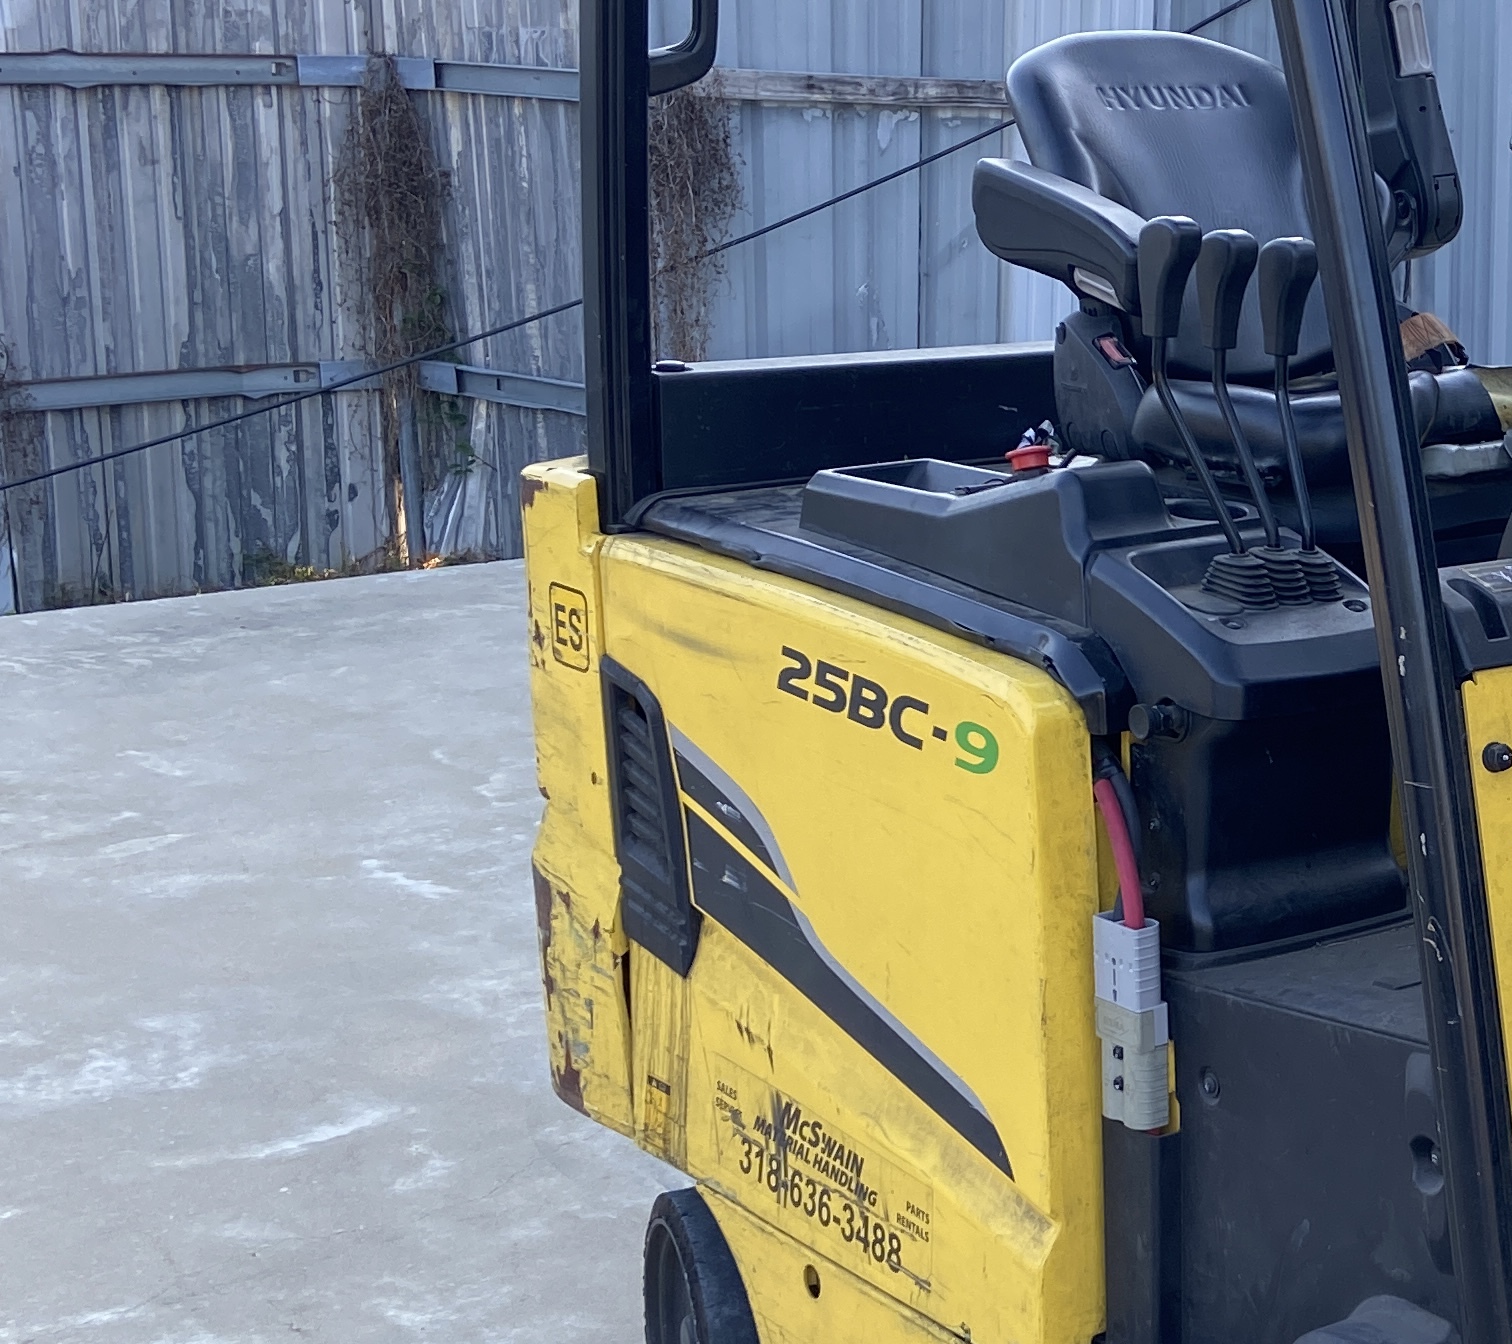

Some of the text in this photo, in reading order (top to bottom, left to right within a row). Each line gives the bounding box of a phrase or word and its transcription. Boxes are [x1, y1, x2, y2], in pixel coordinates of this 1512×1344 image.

[1096, 82, 1251, 111] HYUNDAI
[554, 602, 584, 653] ES
[776, 644, 1000, 775] 25BC-9
[716, 1080, 738, 1101] SALES
[753, 1115, 878, 1207] MARIAL HANDLING
[780, 1100, 865, 1178] McSWAIN
[739, 1138, 902, 1273] 318-636-3488
[896, 1212, 930, 1243] RENTALS
[906, 1200, 930, 1225] PARTS
